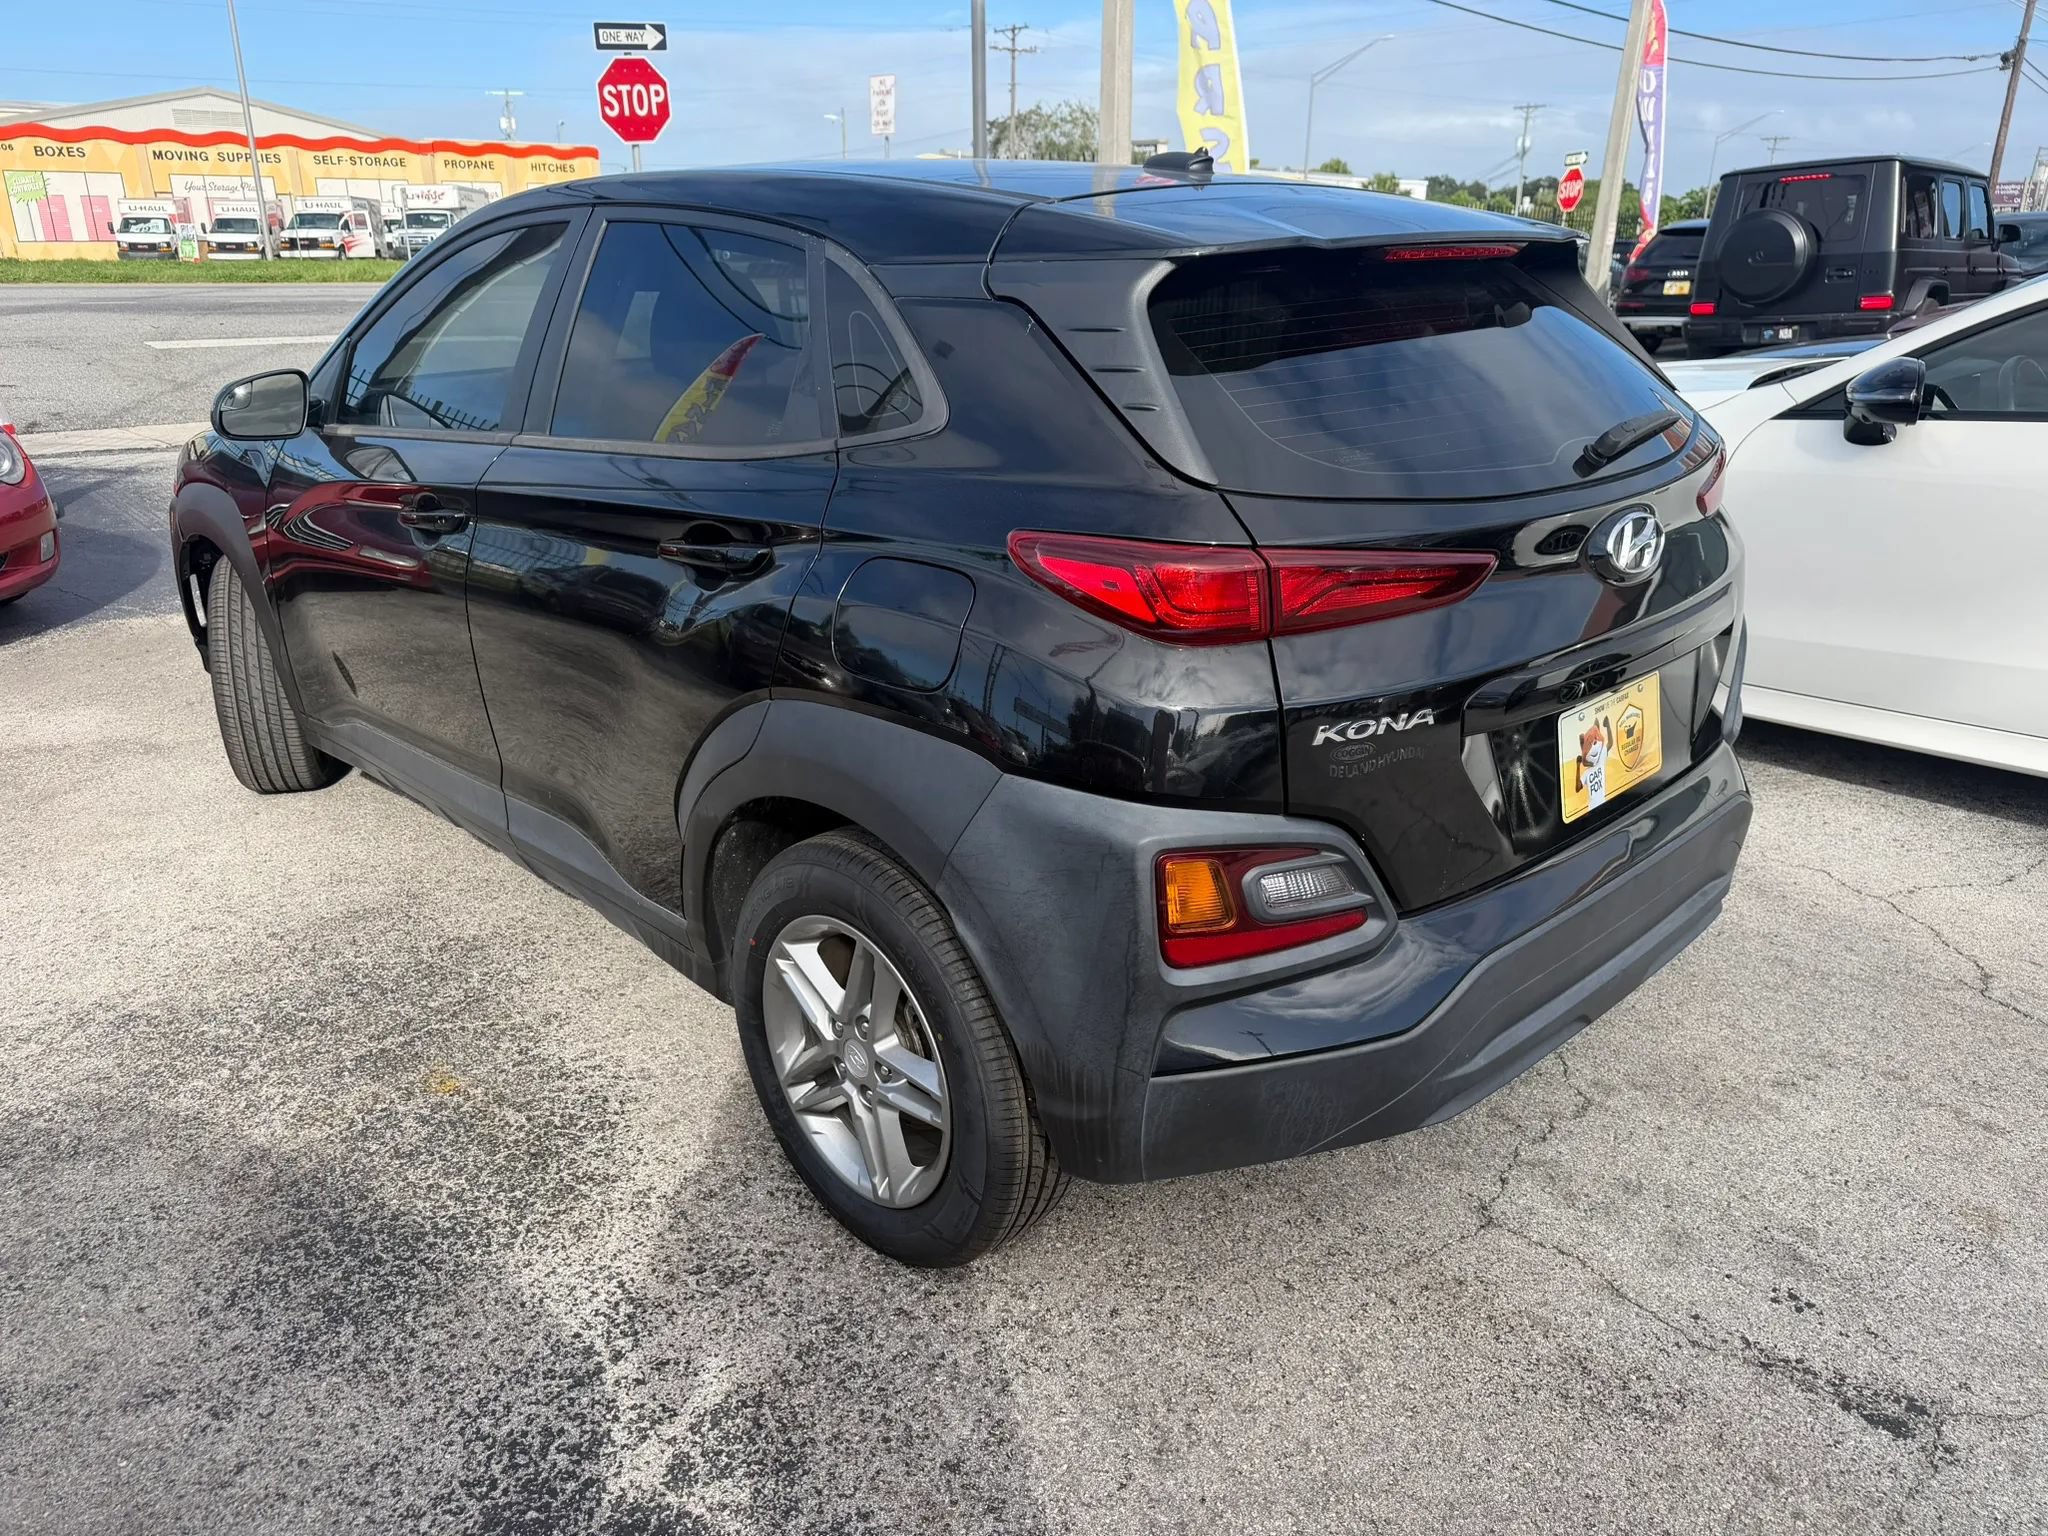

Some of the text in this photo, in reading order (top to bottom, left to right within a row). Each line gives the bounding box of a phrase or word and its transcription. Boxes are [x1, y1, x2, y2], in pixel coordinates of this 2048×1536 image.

[602, 31, 645, 42] ONE WAY
[602, 83, 666, 118] STOP
[0, 143, 14, 151] 06
[33, 145, 86, 158] BOXES
[152, 149, 282, 164] MOVING SUPPIES
[313, 154, 407, 168] SELF-STORAGE
[444, 159, 495, 170] PROPANE
[530, 163, 576, 174] HITCHES
[184, 180, 207, 193] Your
[208, 181, 240, 193] Storage
[1559, 179, 1583, 199] STOP
[128, 204, 168, 212] U-HAUL
[1778, 327, 1793, 340] NBA
[1594, 704, 1605, 714] SHOW
[1311, 708, 1435, 746] KONA
[1329, 746, 1425, 778] DELAND HYUNDAI
[1588, 767, 1602, 783] CAR
[1590, 780, 1603, 796] FOX
